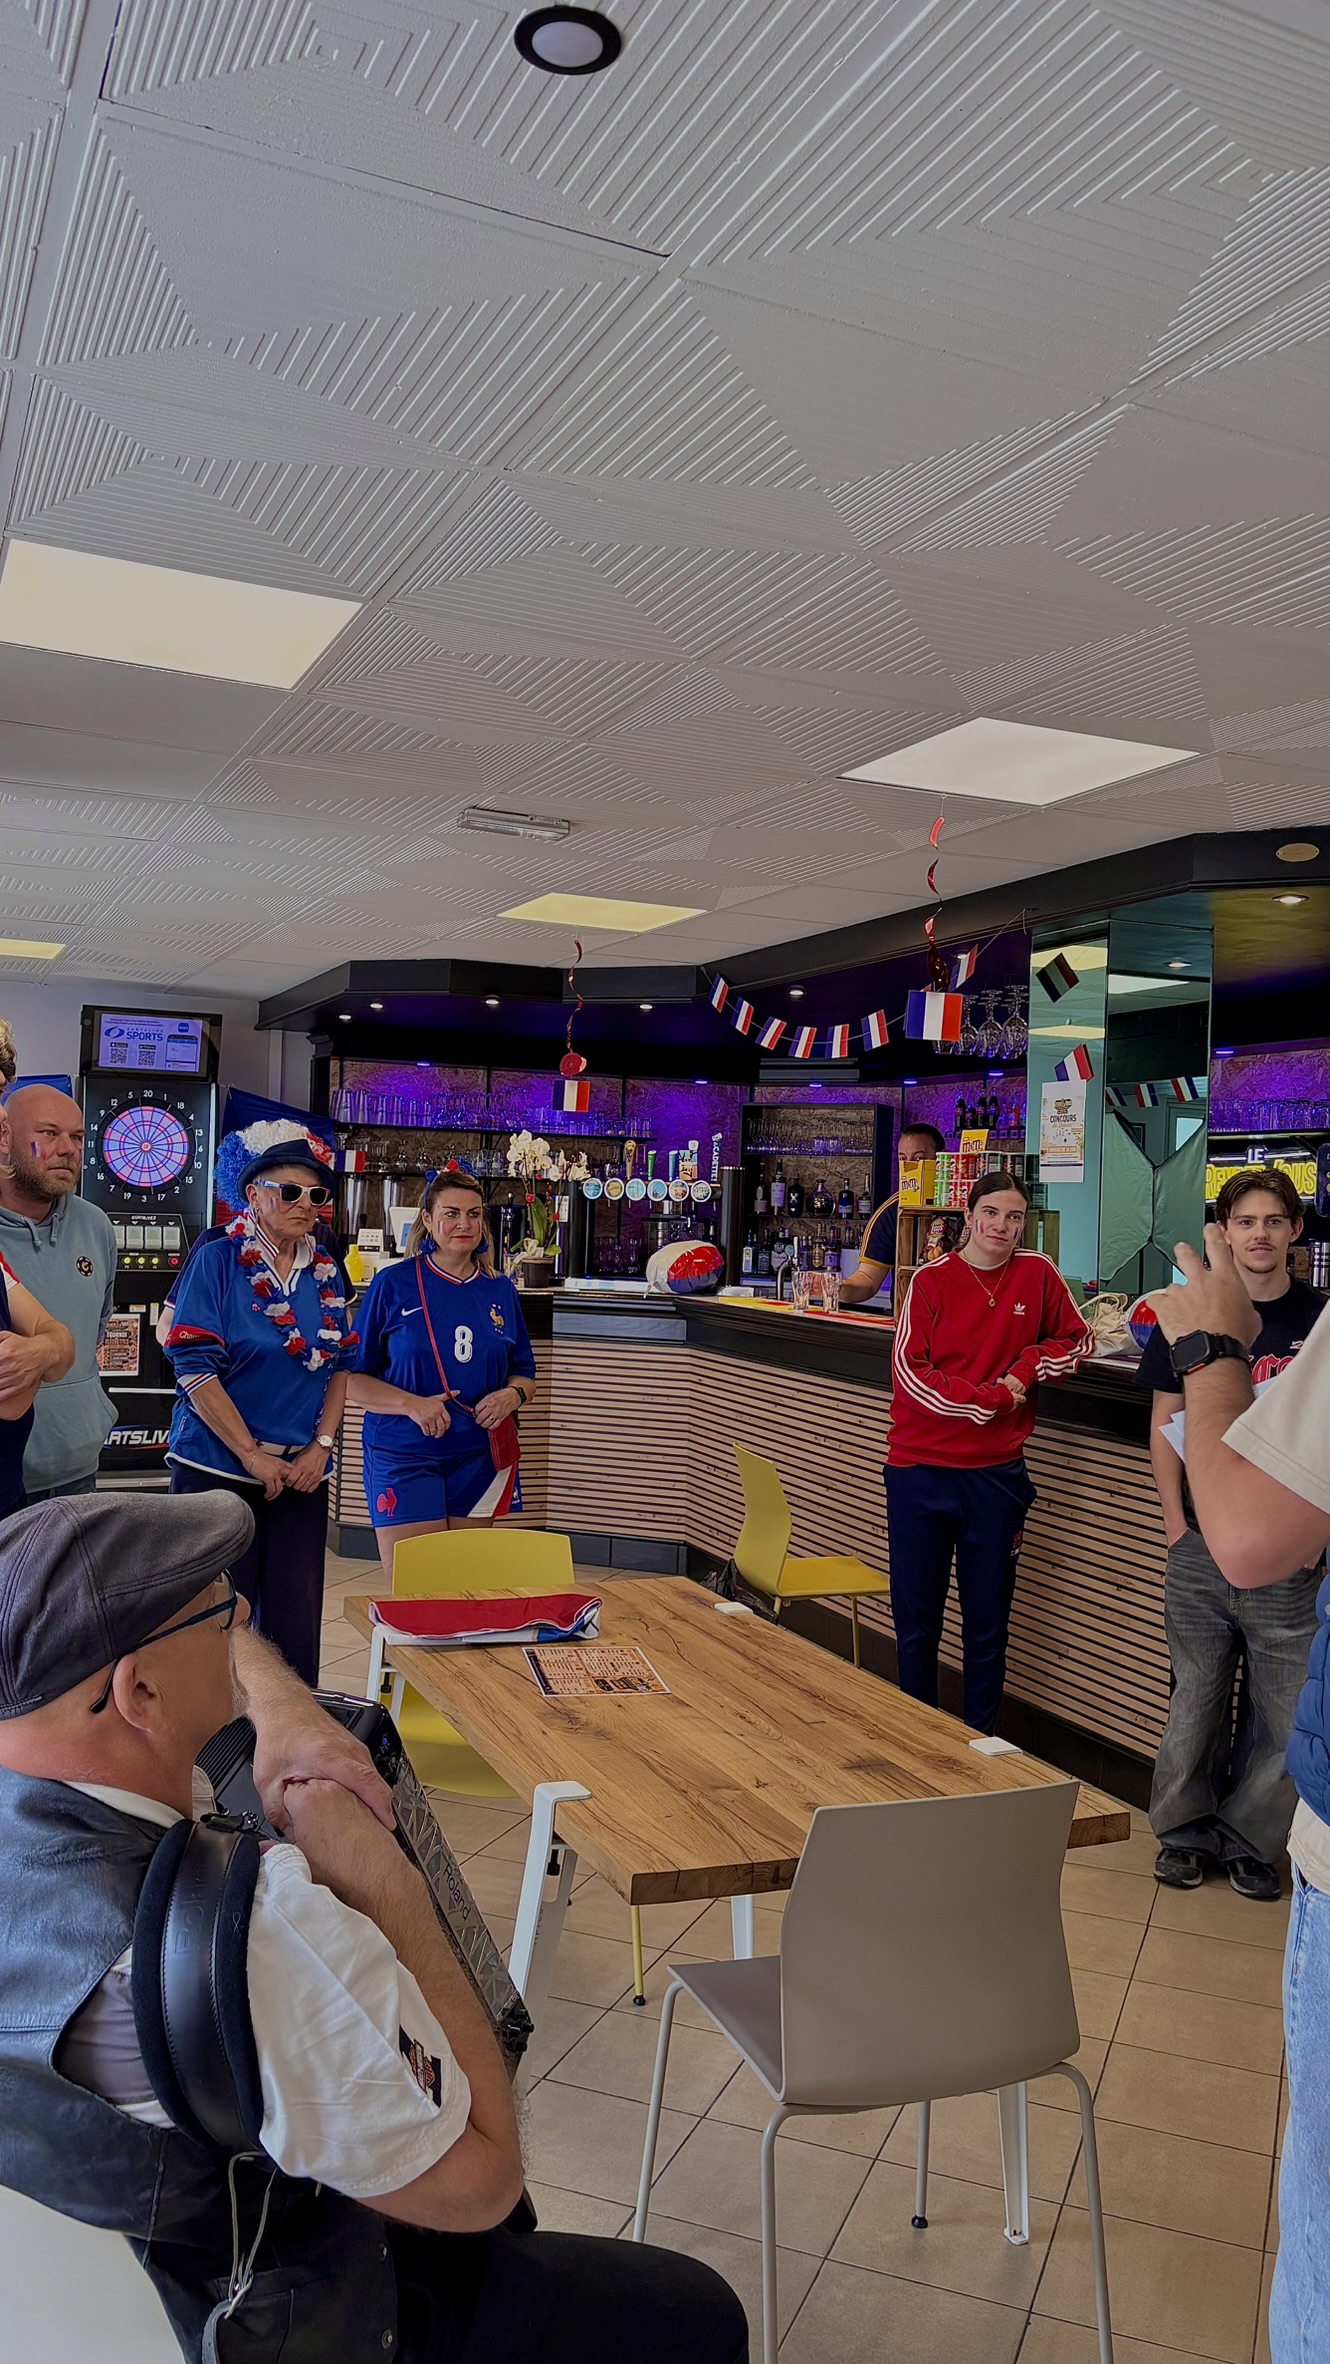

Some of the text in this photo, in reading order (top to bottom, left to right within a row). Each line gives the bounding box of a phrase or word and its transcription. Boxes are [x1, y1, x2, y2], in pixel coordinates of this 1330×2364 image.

[126, 1031, 164, 1042] SPORTS
[177, 1102, 185, 1110] 18
[1050, 1114, 1076, 1123] CONCOURS
[196, 1128, 204, 1136] 13
[198, 1145, 203, 1153] 6
[1247, 1148, 1264, 1164] LE
[124, 1192, 132, 1200] 19
[454, 1325, 473, 1363] 8
[442, 1863, 472, 1921] Roland
